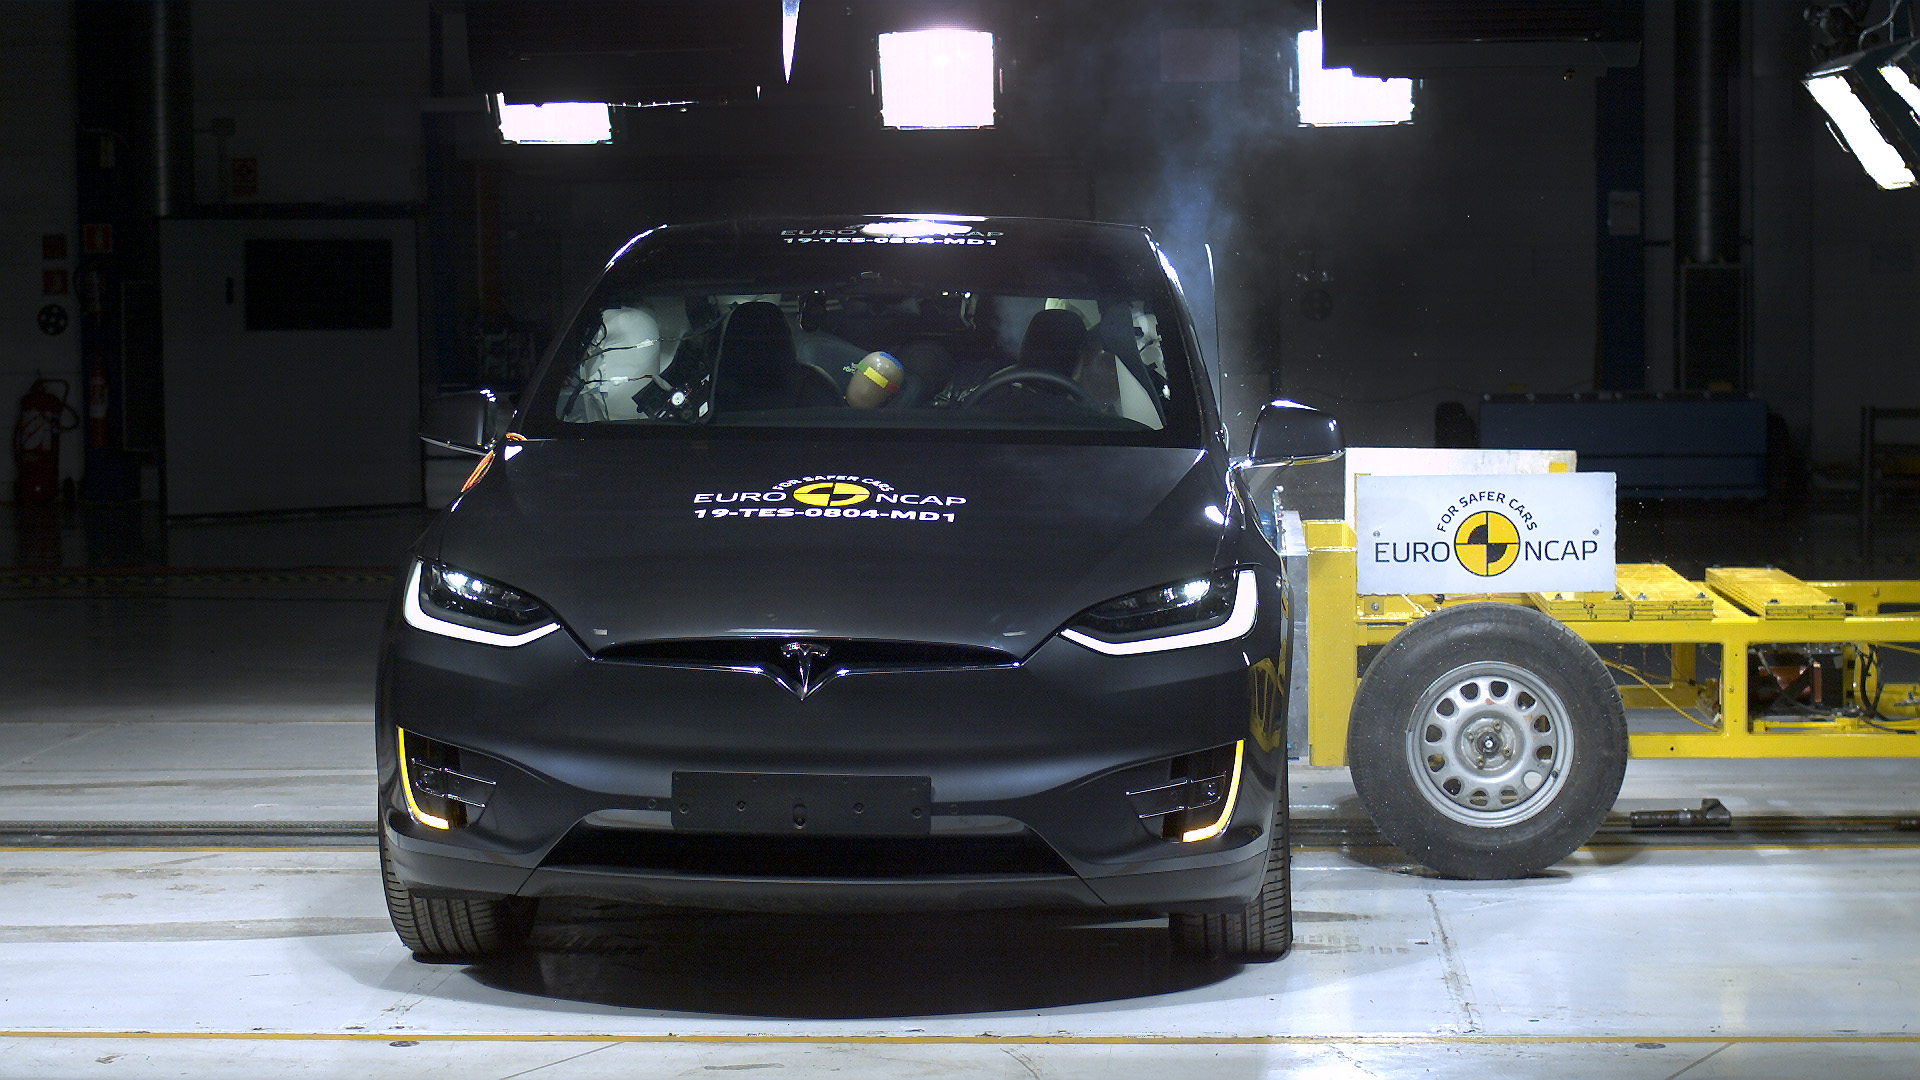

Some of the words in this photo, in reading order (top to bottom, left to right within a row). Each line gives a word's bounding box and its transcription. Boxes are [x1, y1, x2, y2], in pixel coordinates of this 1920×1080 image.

[802, 474, 860, 482] SAFER
[694, 492, 787, 503] EURO
[875, 493, 967, 506] NCAP
[693, 508, 955, 522] 19-TES-0804-MD1
[1436, 505, 1459, 532] FOR
[1458, 491, 1506, 508] SAFER
[1508, 498, 1538, 531] CARS
[1374, 541, 1451, 563] EURO
[1524, 540, 1598, 562] NCAP
